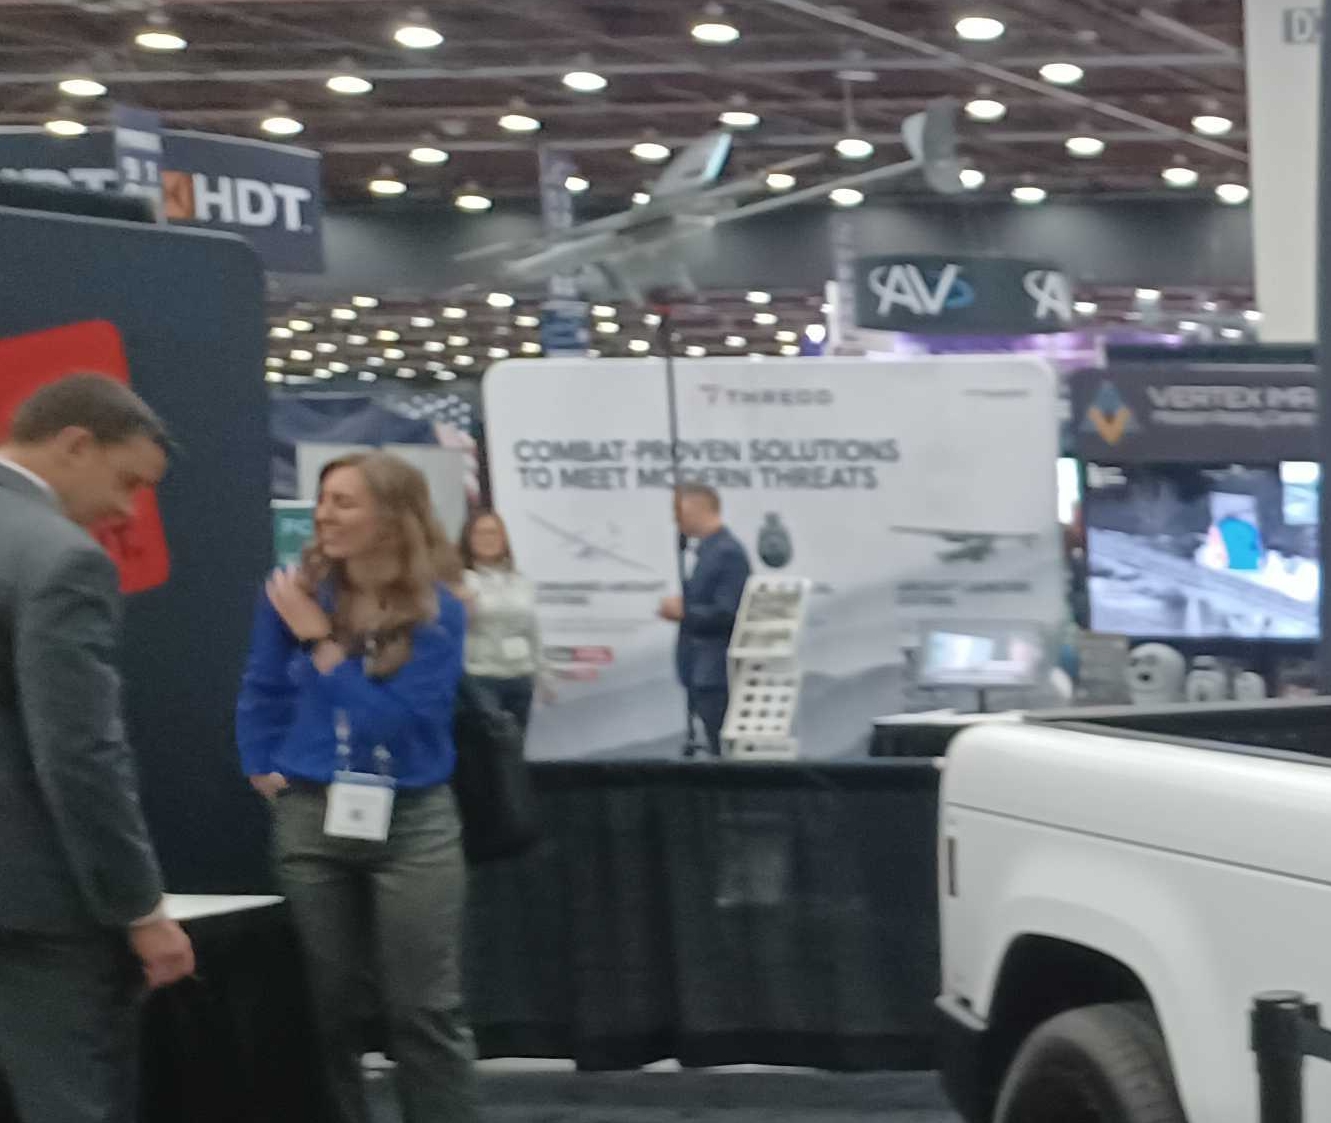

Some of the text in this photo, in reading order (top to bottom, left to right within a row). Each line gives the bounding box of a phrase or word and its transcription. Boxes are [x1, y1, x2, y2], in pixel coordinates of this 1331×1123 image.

[192, 172, 312, 232] HDT
[1145, 385, 1264, 408] VERTEX
[749, 438, 900, 463] SOLUTIONS
[517, 465, 879, 490] TO MEET MODERN THREATS
